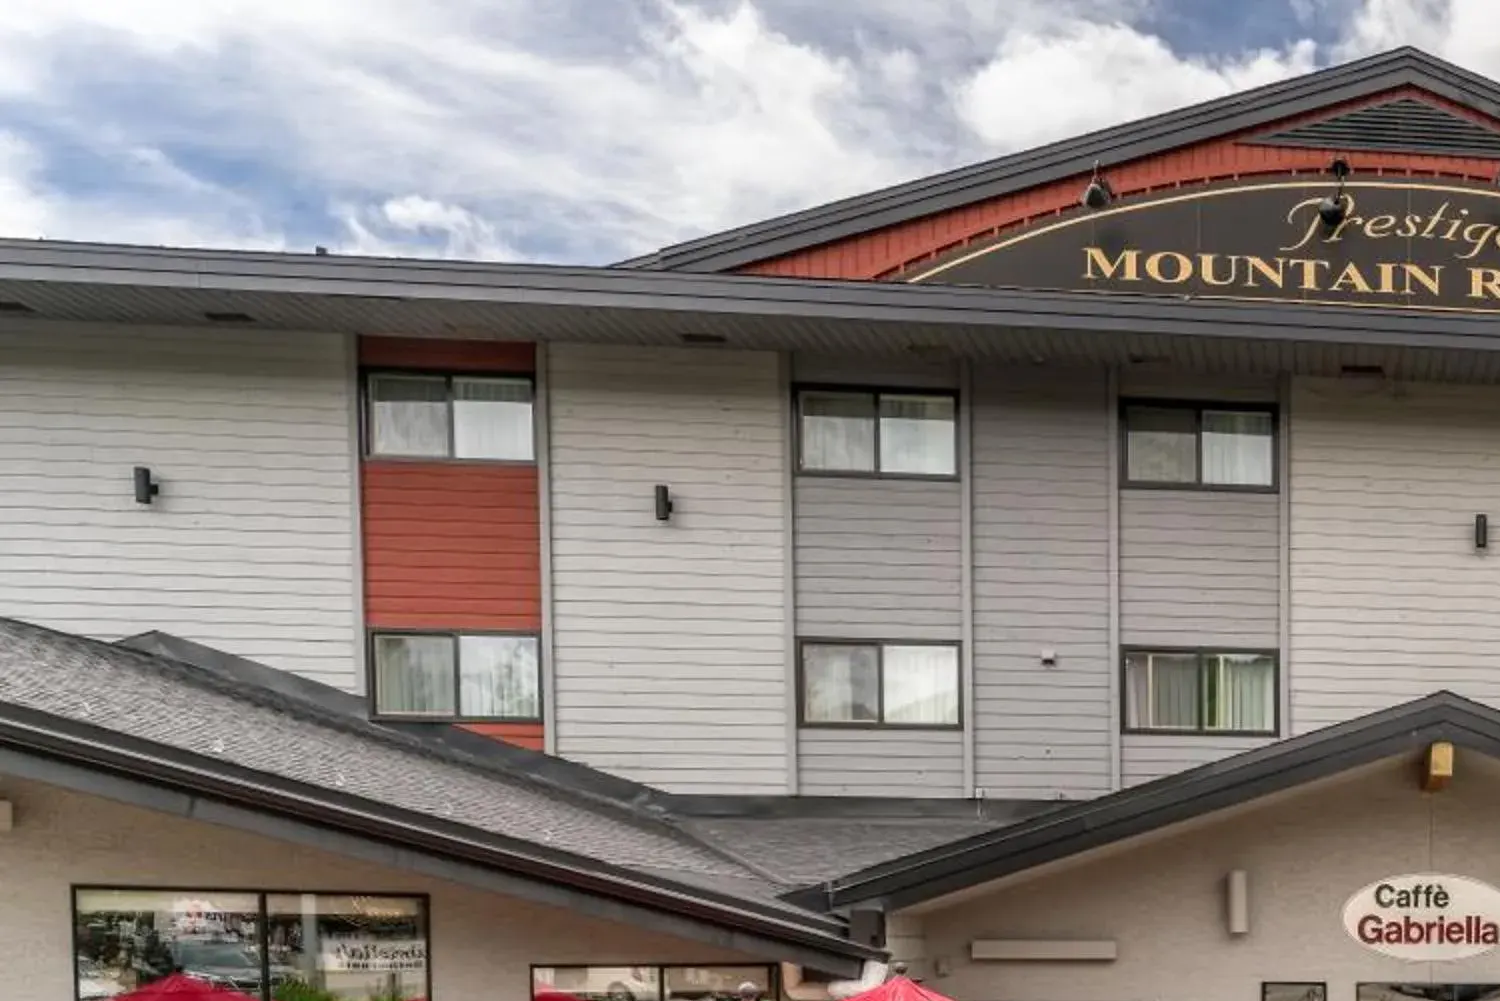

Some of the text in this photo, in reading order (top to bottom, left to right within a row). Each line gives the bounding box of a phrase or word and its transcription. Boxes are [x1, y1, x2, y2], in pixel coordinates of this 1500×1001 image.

[1083, 248, 1444, 295] MOUNTAIN
[1374, 883, 1449, 908] Caffè
[1357, 914, 1499, 944] Gabriella
